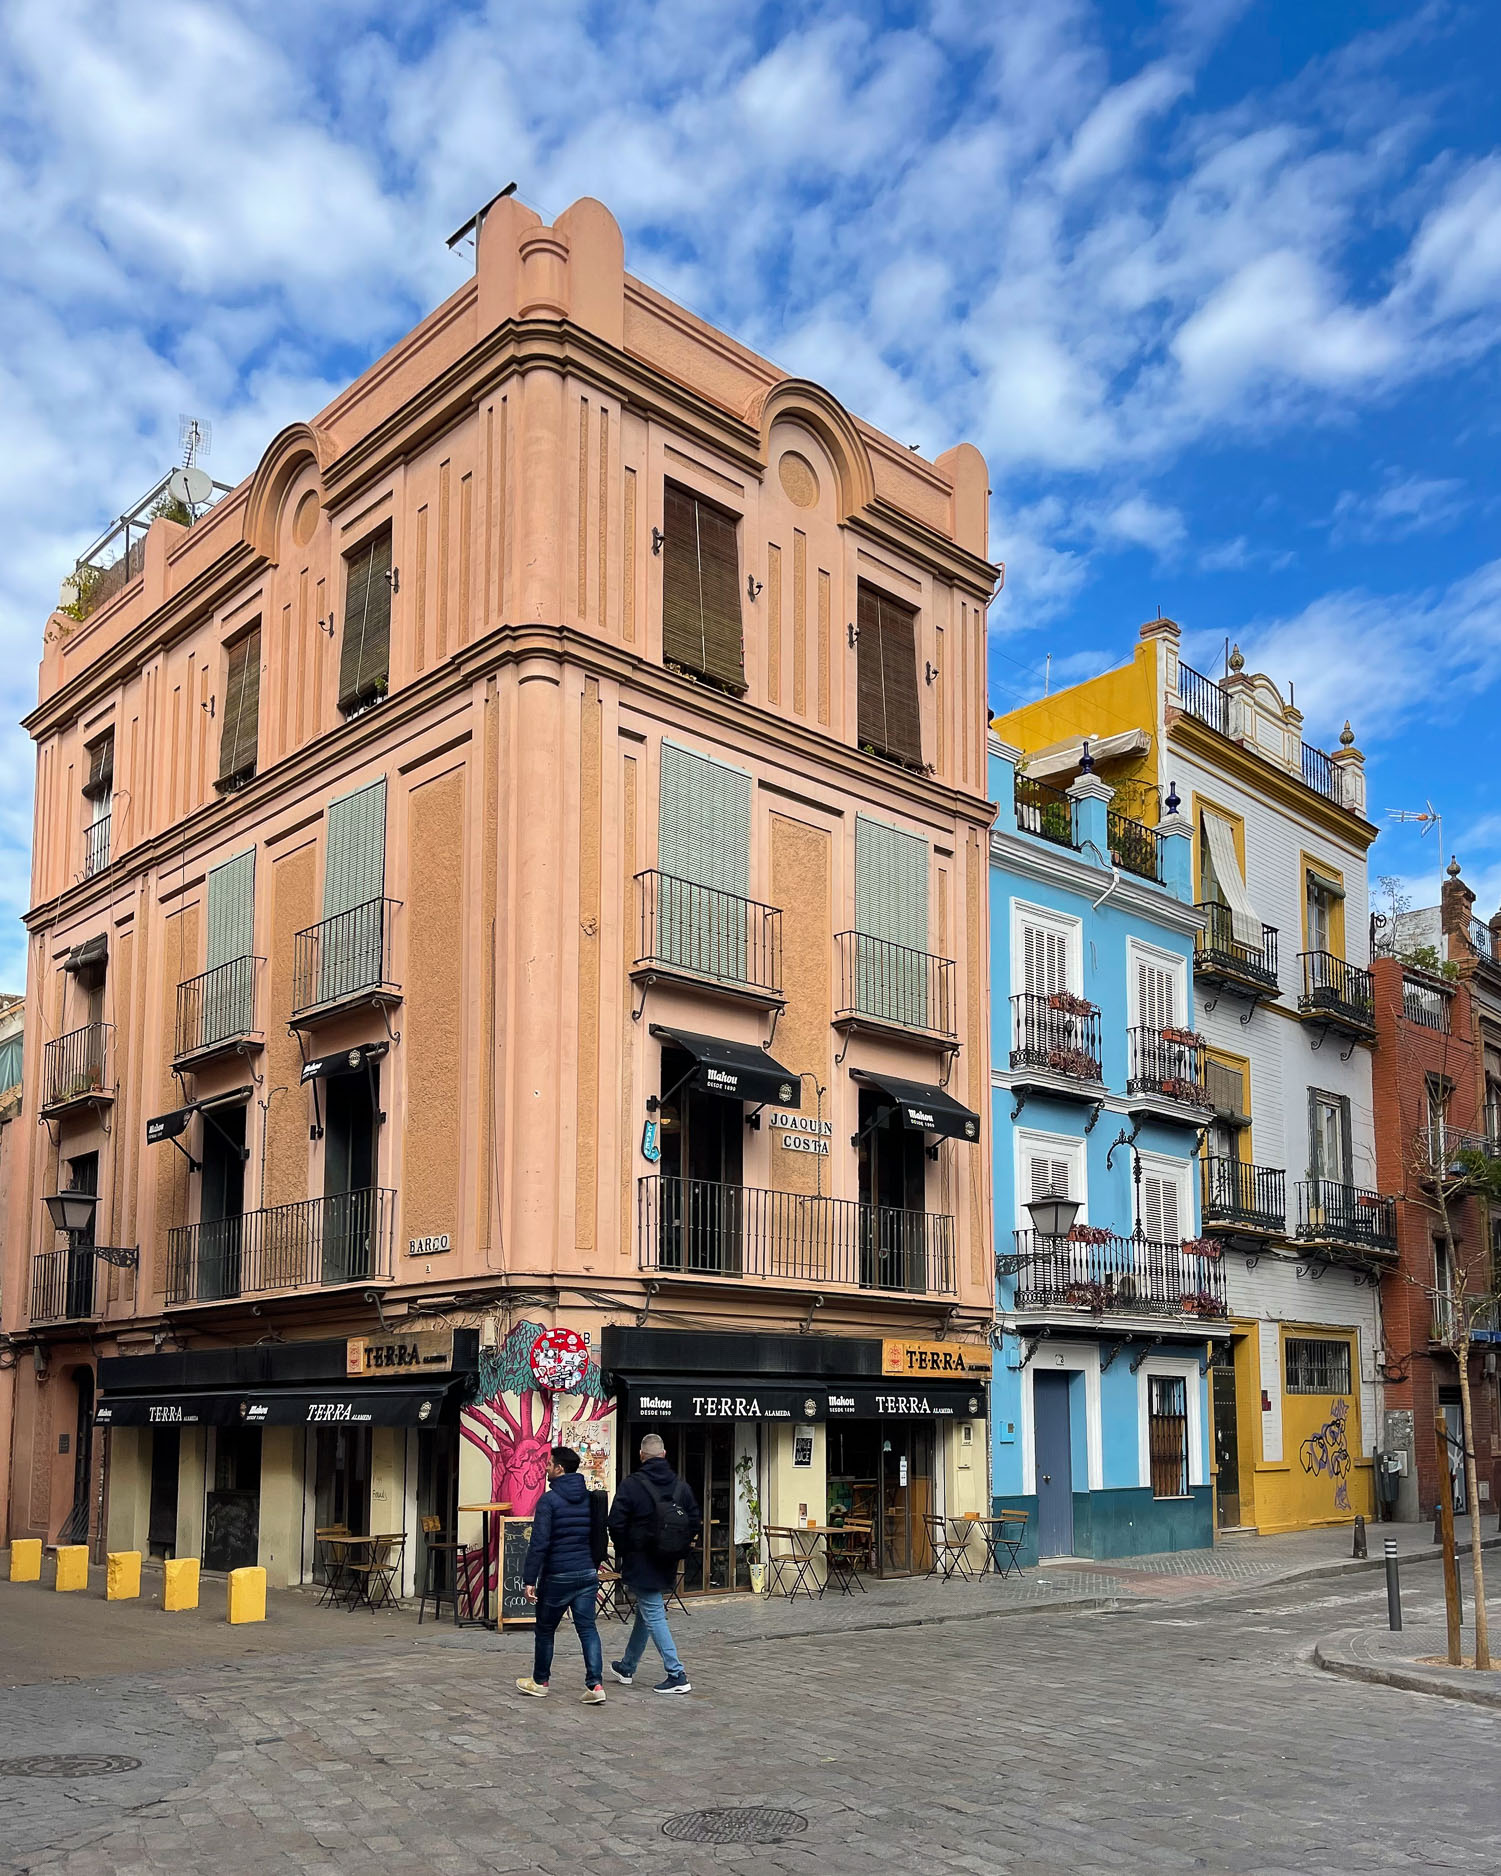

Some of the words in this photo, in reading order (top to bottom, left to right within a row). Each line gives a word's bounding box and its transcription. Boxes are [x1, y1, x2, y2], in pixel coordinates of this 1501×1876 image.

[707, 1068, 738, 1085] Mahou
[907, 1108, 934, 1123] Mahou
[783, 1135, 829, 1153] COSTA
[409, 1235, 449, 1253] BARCO
[639, 1396, 672, 1408] Mahou
[828, 1395, 855, 1406] Mahou
[764, 1409, 791, 1417] ALAMEDA
[504, 1595, 527, 1608] GOOD
